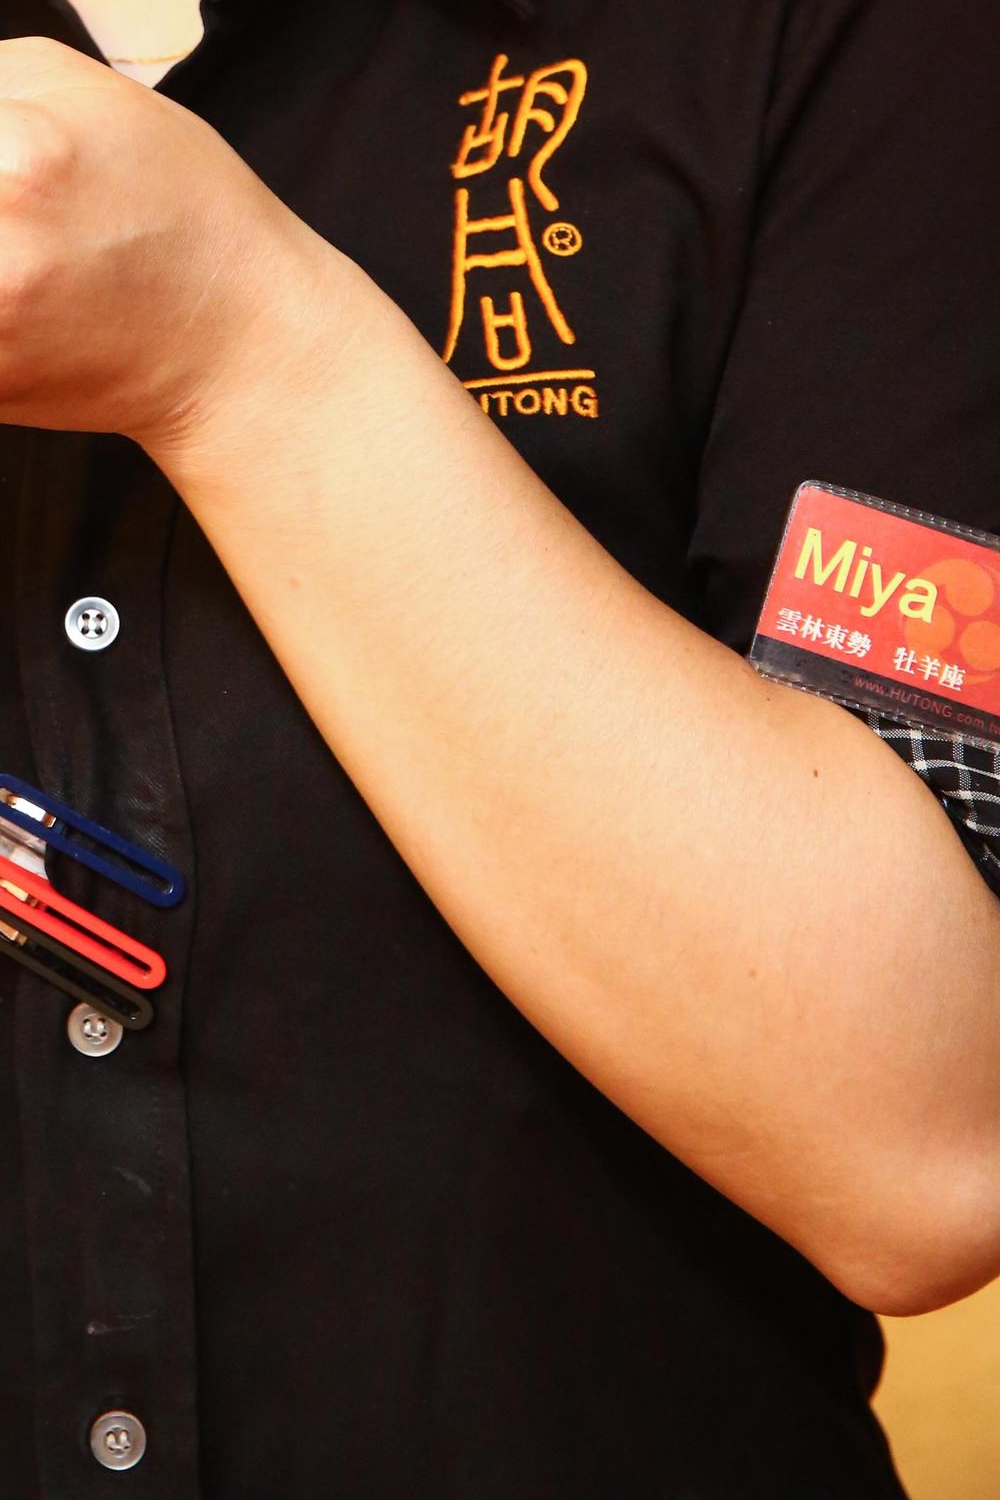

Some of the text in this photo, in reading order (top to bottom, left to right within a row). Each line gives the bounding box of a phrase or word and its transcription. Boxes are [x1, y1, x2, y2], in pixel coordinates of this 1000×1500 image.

[793, 526, 939, 625] Miya
[776, 606, 967, 692] 雲林東勢 牡羊座
